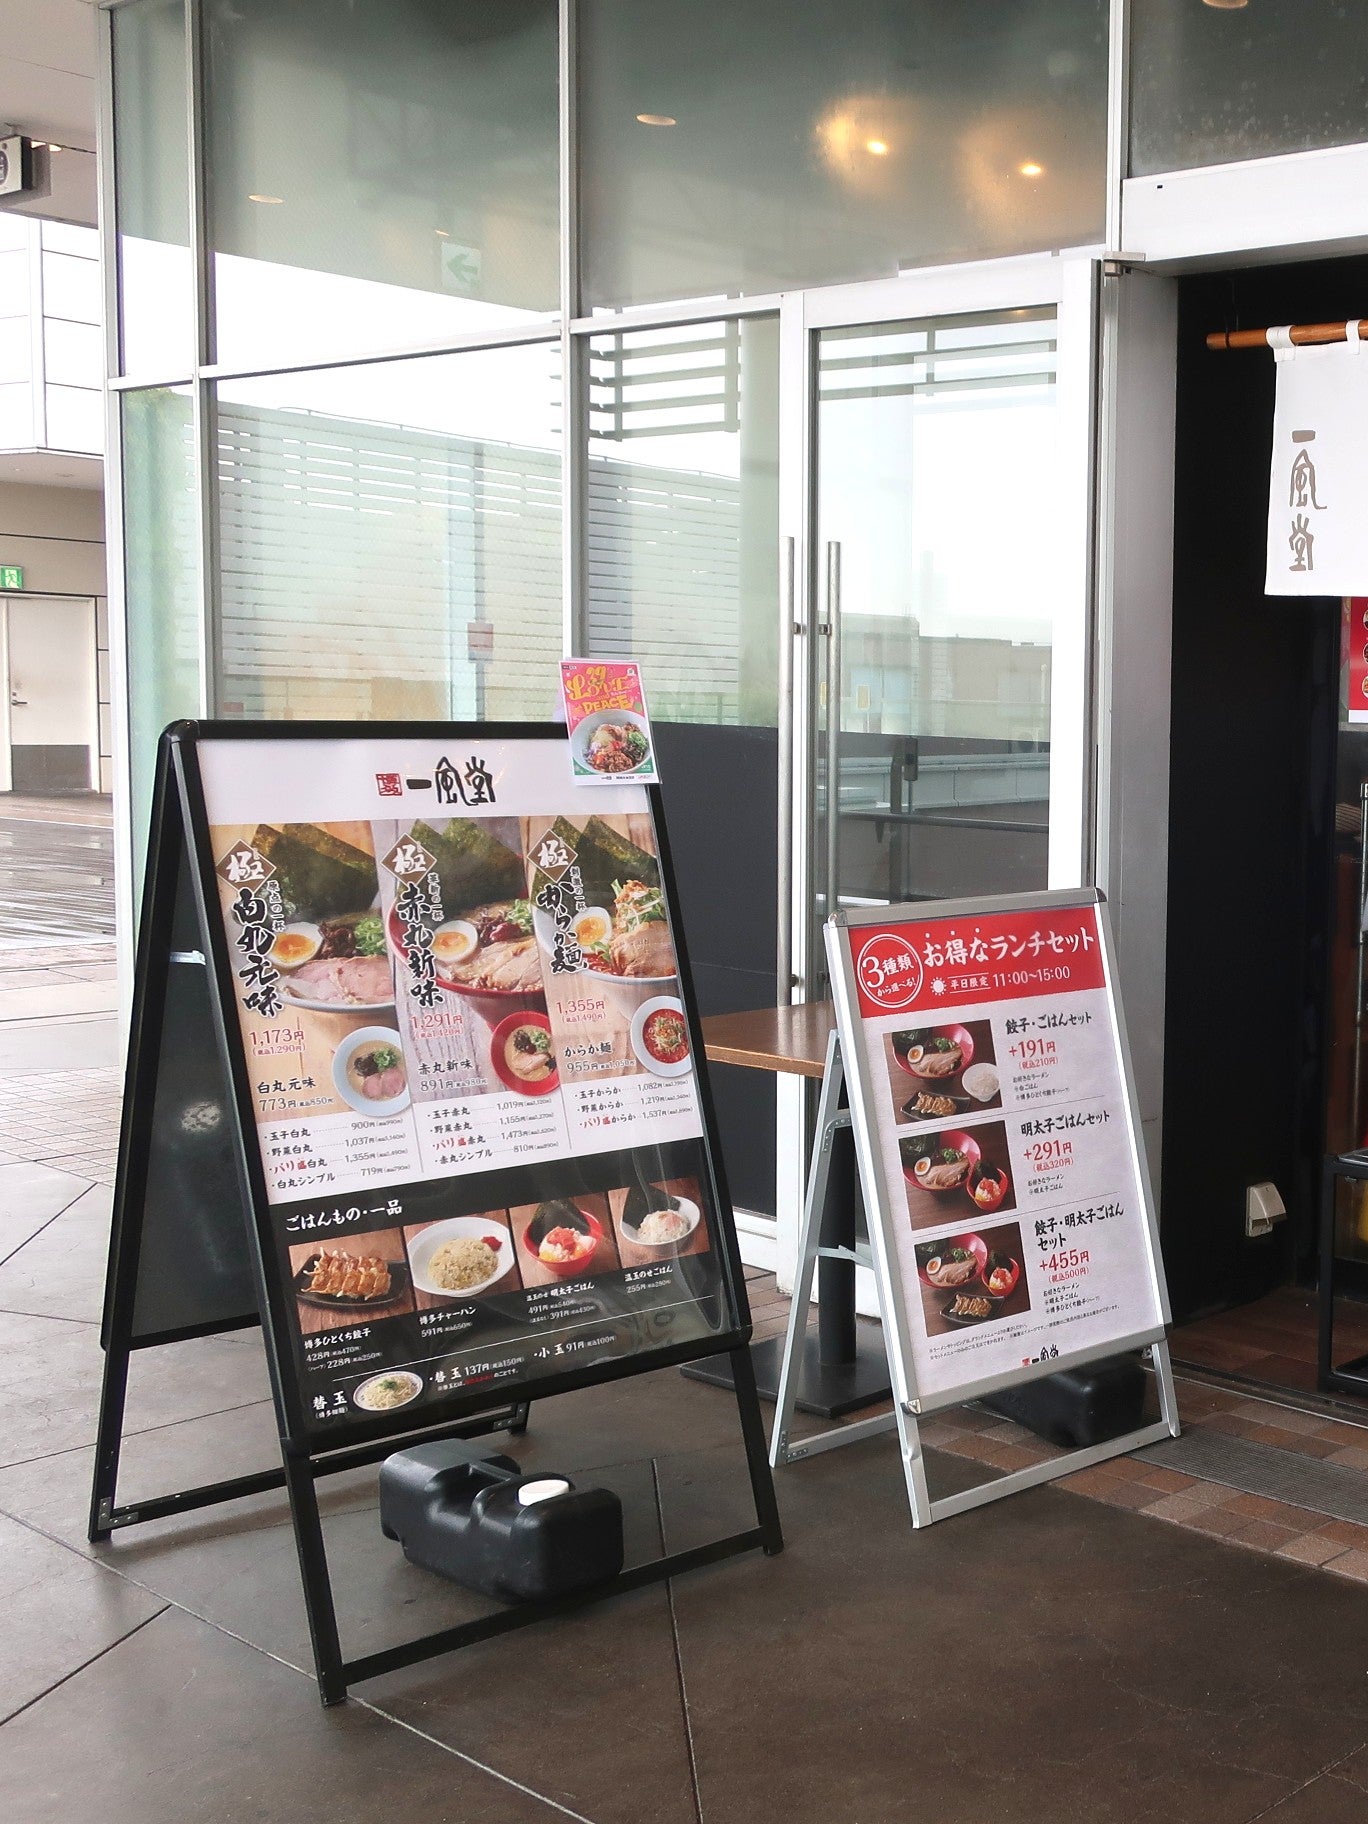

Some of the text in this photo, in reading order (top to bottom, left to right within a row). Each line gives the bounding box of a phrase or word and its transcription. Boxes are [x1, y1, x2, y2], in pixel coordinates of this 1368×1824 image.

[1289, 429, 1327, 571] 一風堂
[582, 694, 632, 714] PEACE
[406, 756, 496, 806] 一風堂
[226, 848, 265, 882] 極
[393, 843, 426, 875] 極
[538, 838, 568, 868] 極
[536, 882, 588, 973] からか麺
[397, 882, 443, 1007] 赤丸新味
[923, 927, 1095, 967] お得なランチセット
[862, 953, 915, 989] 3種類
[950, 976, 989, 991] 平日限定
[556, 999, 605, 1015] 1,355円
[410, 1013, 463, 1030] 1,291円
[1005, 1011, 1092, 1035] 餃子・ごはんセット
[250, 1028, 304, 1046] 1,173円
[1009, 1038, 1056, 1058] +191円
[564, 1042, 612, 1058] からか麺
[418, 1059, 473, 1076] 赤丸新味
[257, 1077, 316, 1094] 白丸元味
[1020, 1111, 1111, 1137] 明太子ごはんセット
[1023, 1139, 1073, 1163] +291円
[285, 1199, 403, 1232] ごはんもの・一品
[1034, 1203, 1125, 1237] 餃子・明太子ごはん
[1037, 1232, 1067, 1251] セット
[1039, 1249, 1090, 1271] +455円
[419, 1305, 478, 1326] 博多チャーハン
[304, 1327, 372, 1350] 博多ひとくち餃子
